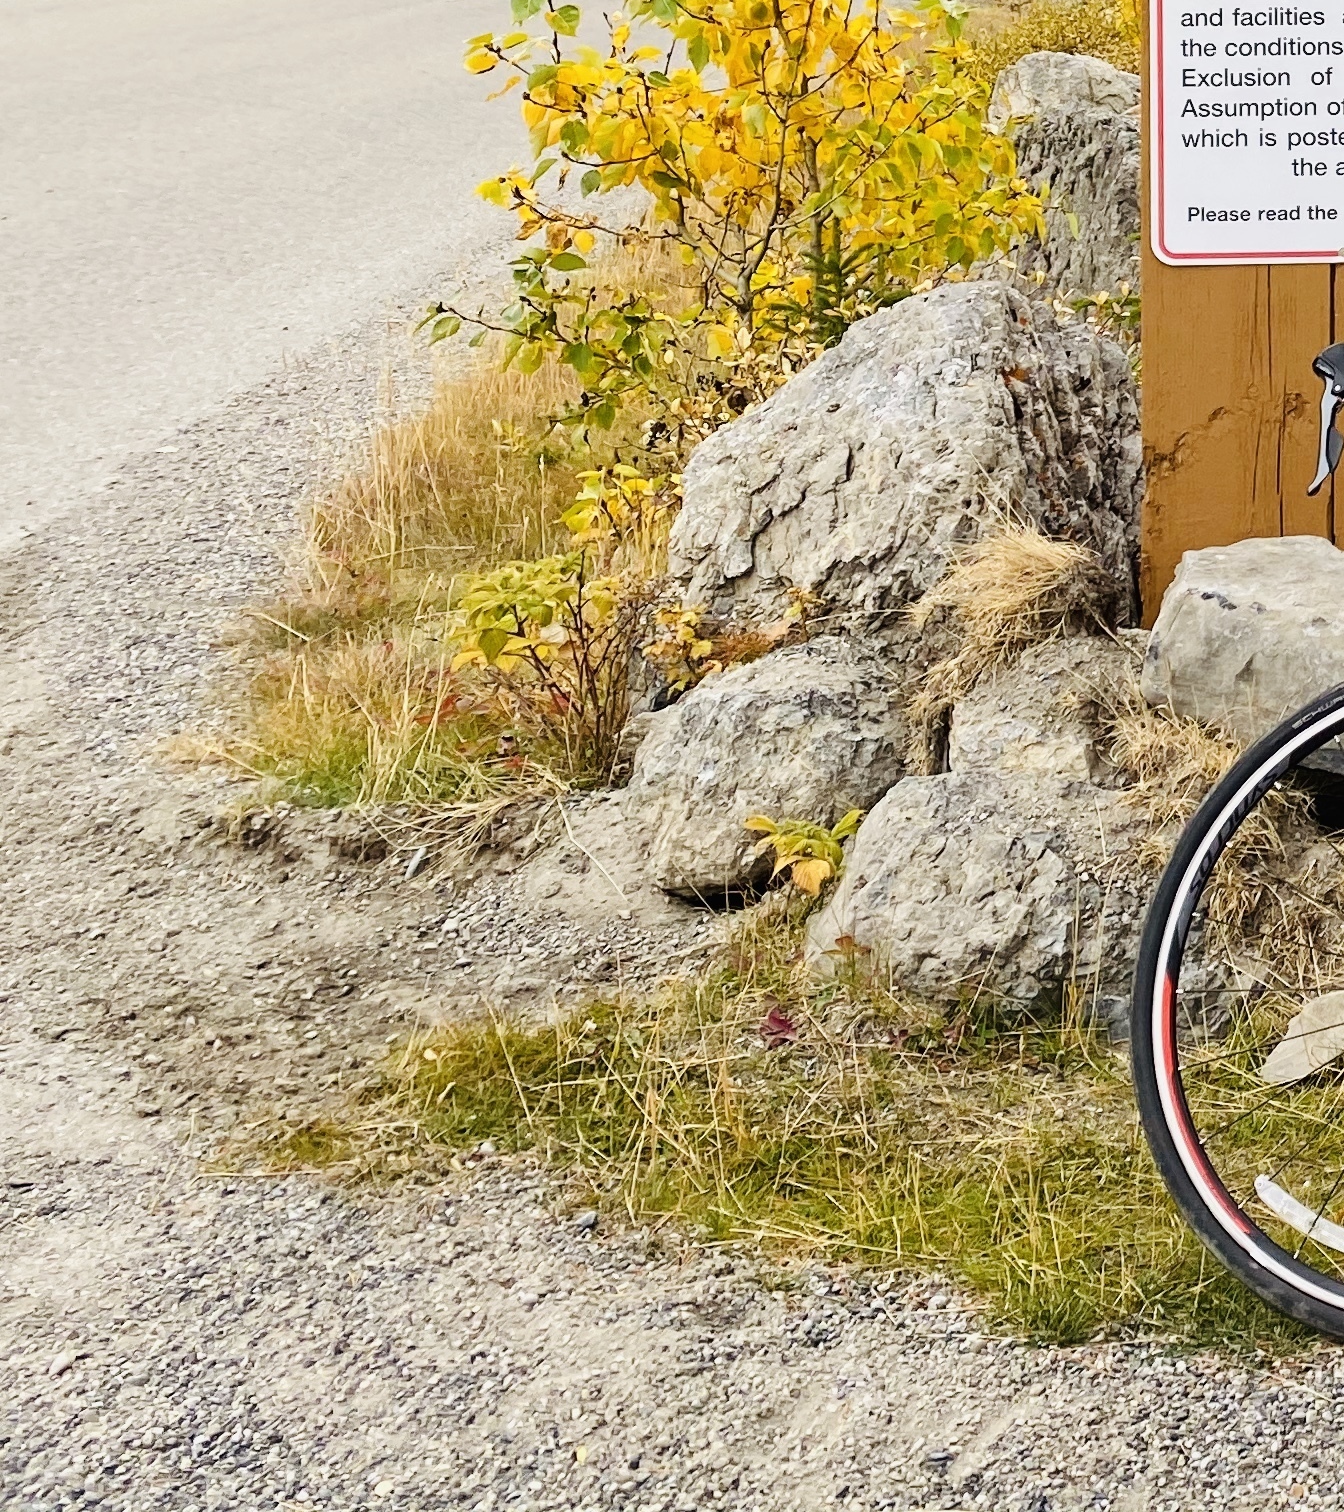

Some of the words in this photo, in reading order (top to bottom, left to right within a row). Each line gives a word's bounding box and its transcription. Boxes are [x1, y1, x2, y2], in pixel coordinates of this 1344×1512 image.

[1181, 8, 1222, 26] and
[1232, 7, 1324, 26] facilities
[1181, 39, 1216, 56] the
[1225, 37, 1343, 56] conditions
[1183, 68, 1290, 87] Exclusion
[1311, 67, 1332, 85] of
[1181, 98, 1316, 119] Assumption
[1182, 129, 1247, 147] which
[1260, 128, 1276, 146] is
[1292, 158, 1327, 176] the
[1188, 207, 1250, 221] Please
[1259, 206, 1300, 220] read
[1307, 205, 1337, 220] the
